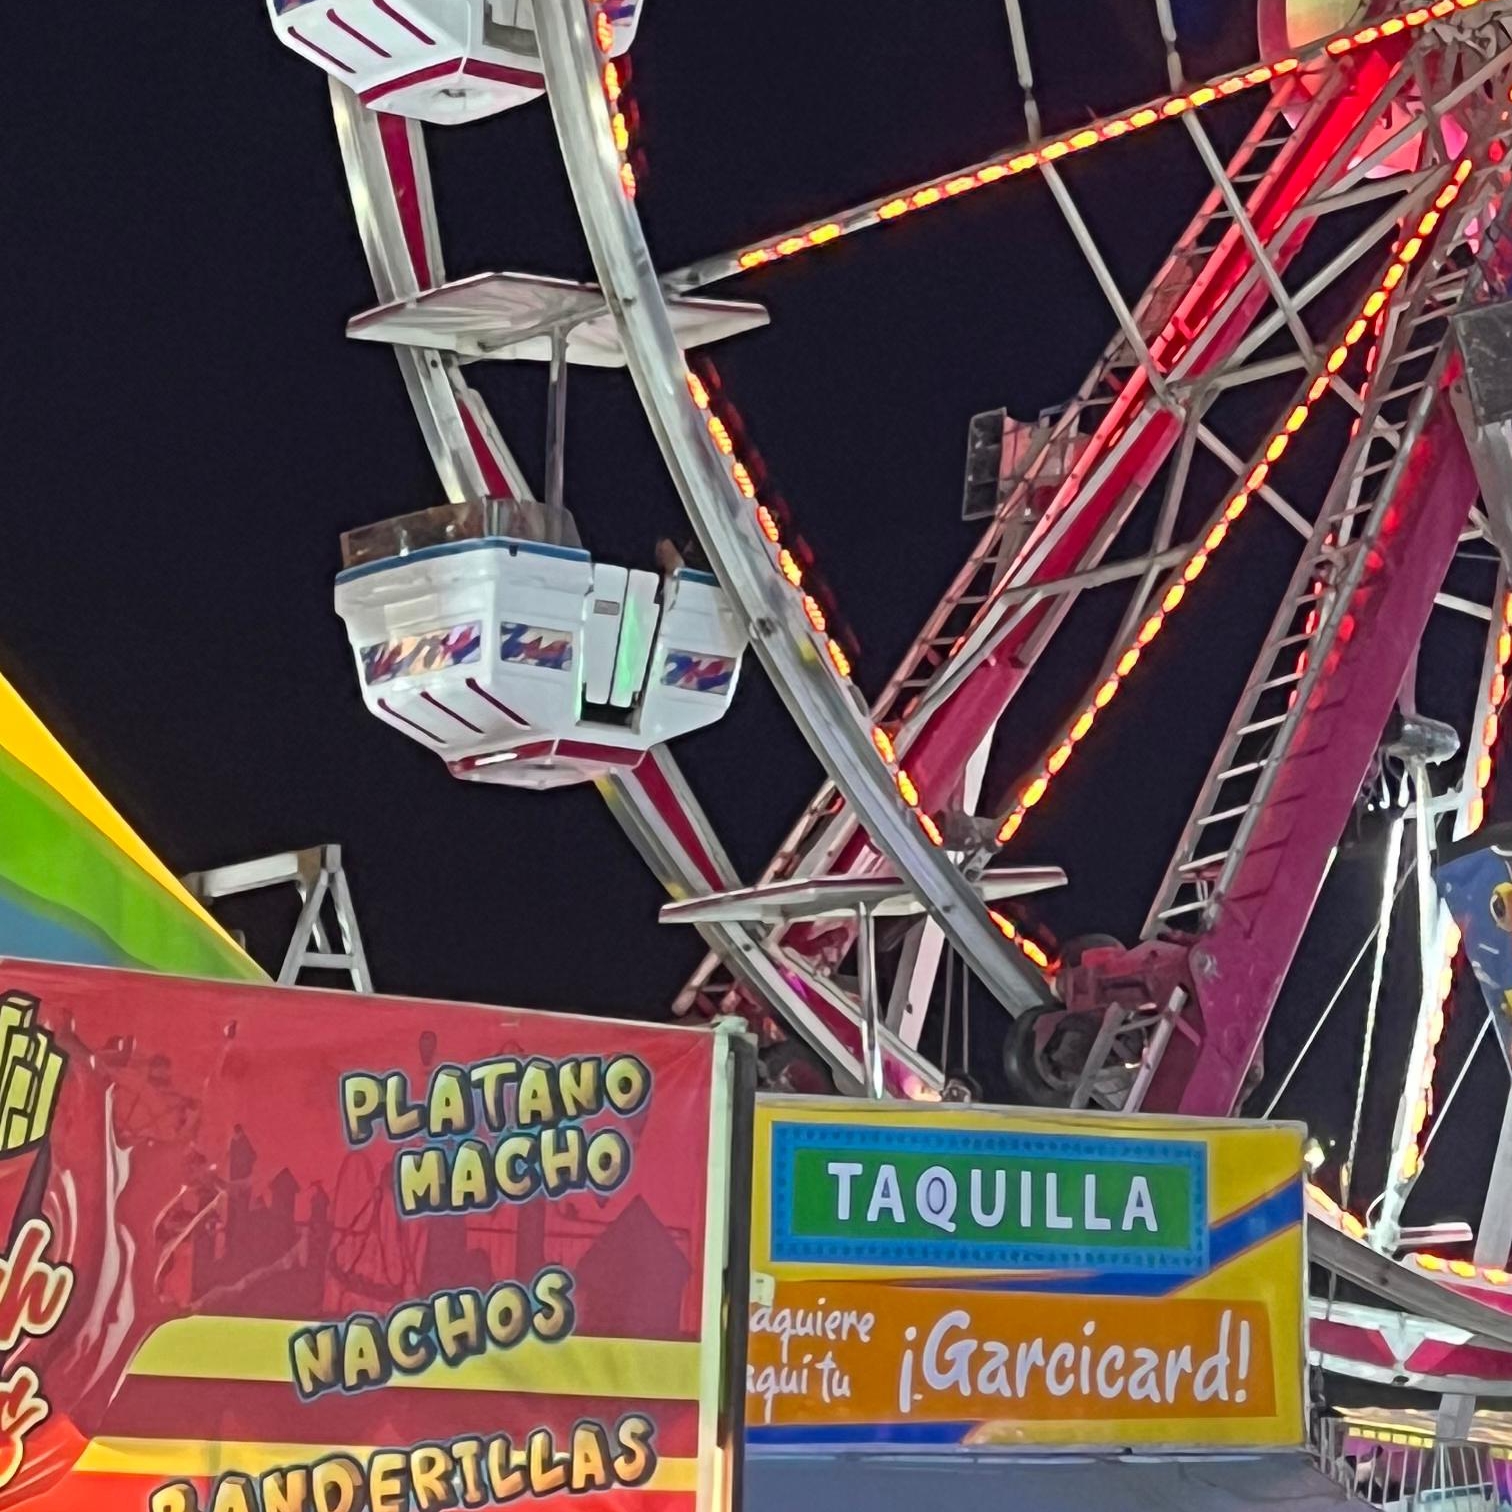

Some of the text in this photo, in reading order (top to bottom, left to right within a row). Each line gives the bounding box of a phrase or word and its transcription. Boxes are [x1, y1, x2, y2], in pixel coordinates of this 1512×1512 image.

[341, 1054, 651, 1144] PLATANO
[398, 1126, 632, 1216] MACHO
[827, 1161, 1159, 1233] TAQUILLA
[288, 1266, 574, 1400] NACHOS
[814, 1350, 852, 1404] tu
